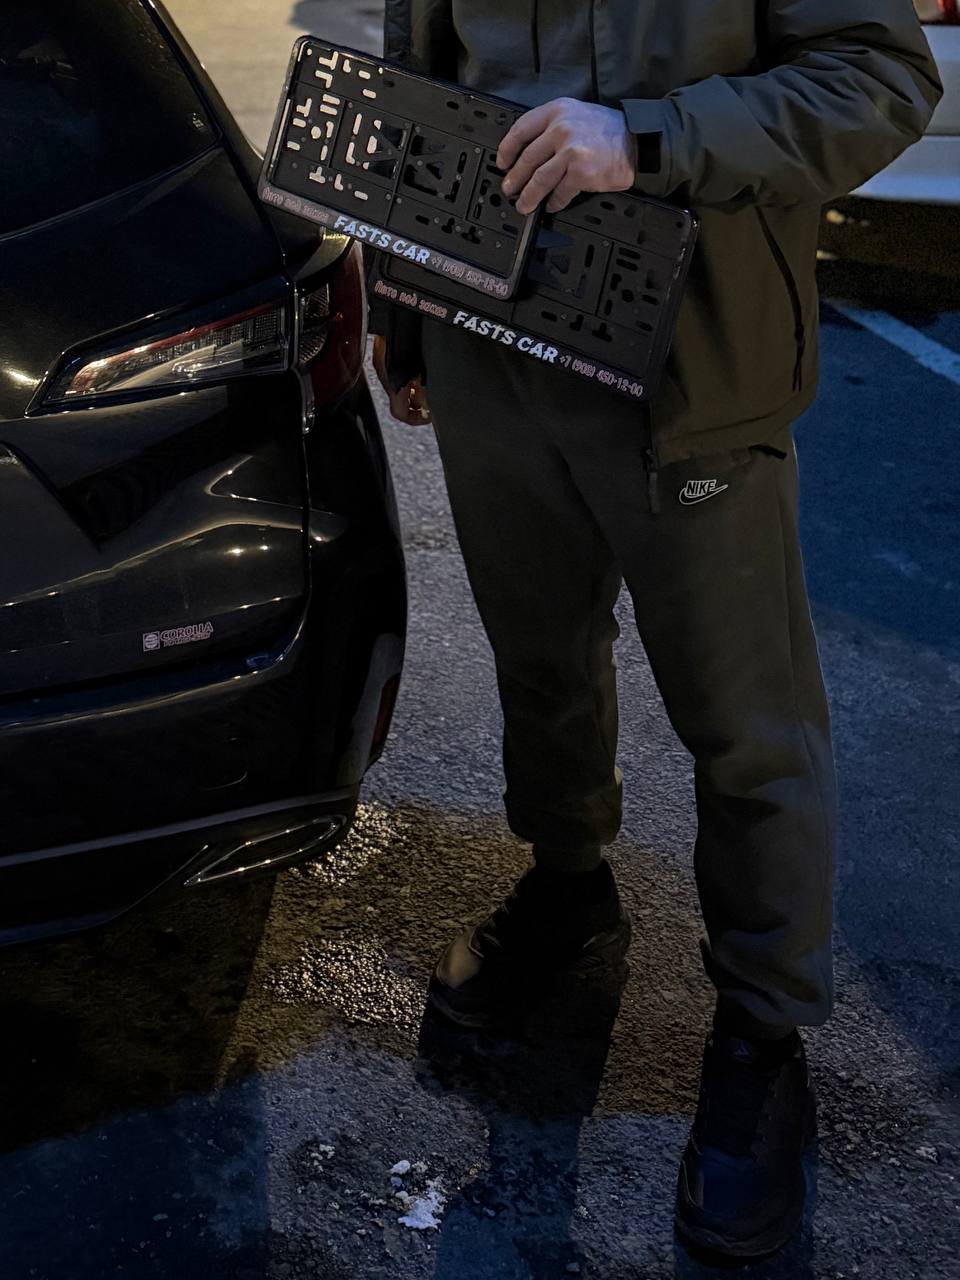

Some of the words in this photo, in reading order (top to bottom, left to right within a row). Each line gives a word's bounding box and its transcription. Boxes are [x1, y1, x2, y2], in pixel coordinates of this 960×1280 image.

[333, 215, 391, 248] FASTS
[392, 239, 431, 265] CAR
[452, 310, 516, 346] FASTS
[516, 336, 559, 364] CAR
[686, 480, 716, 495] NIKE
[160, 621, 214, 641] COROLLA
